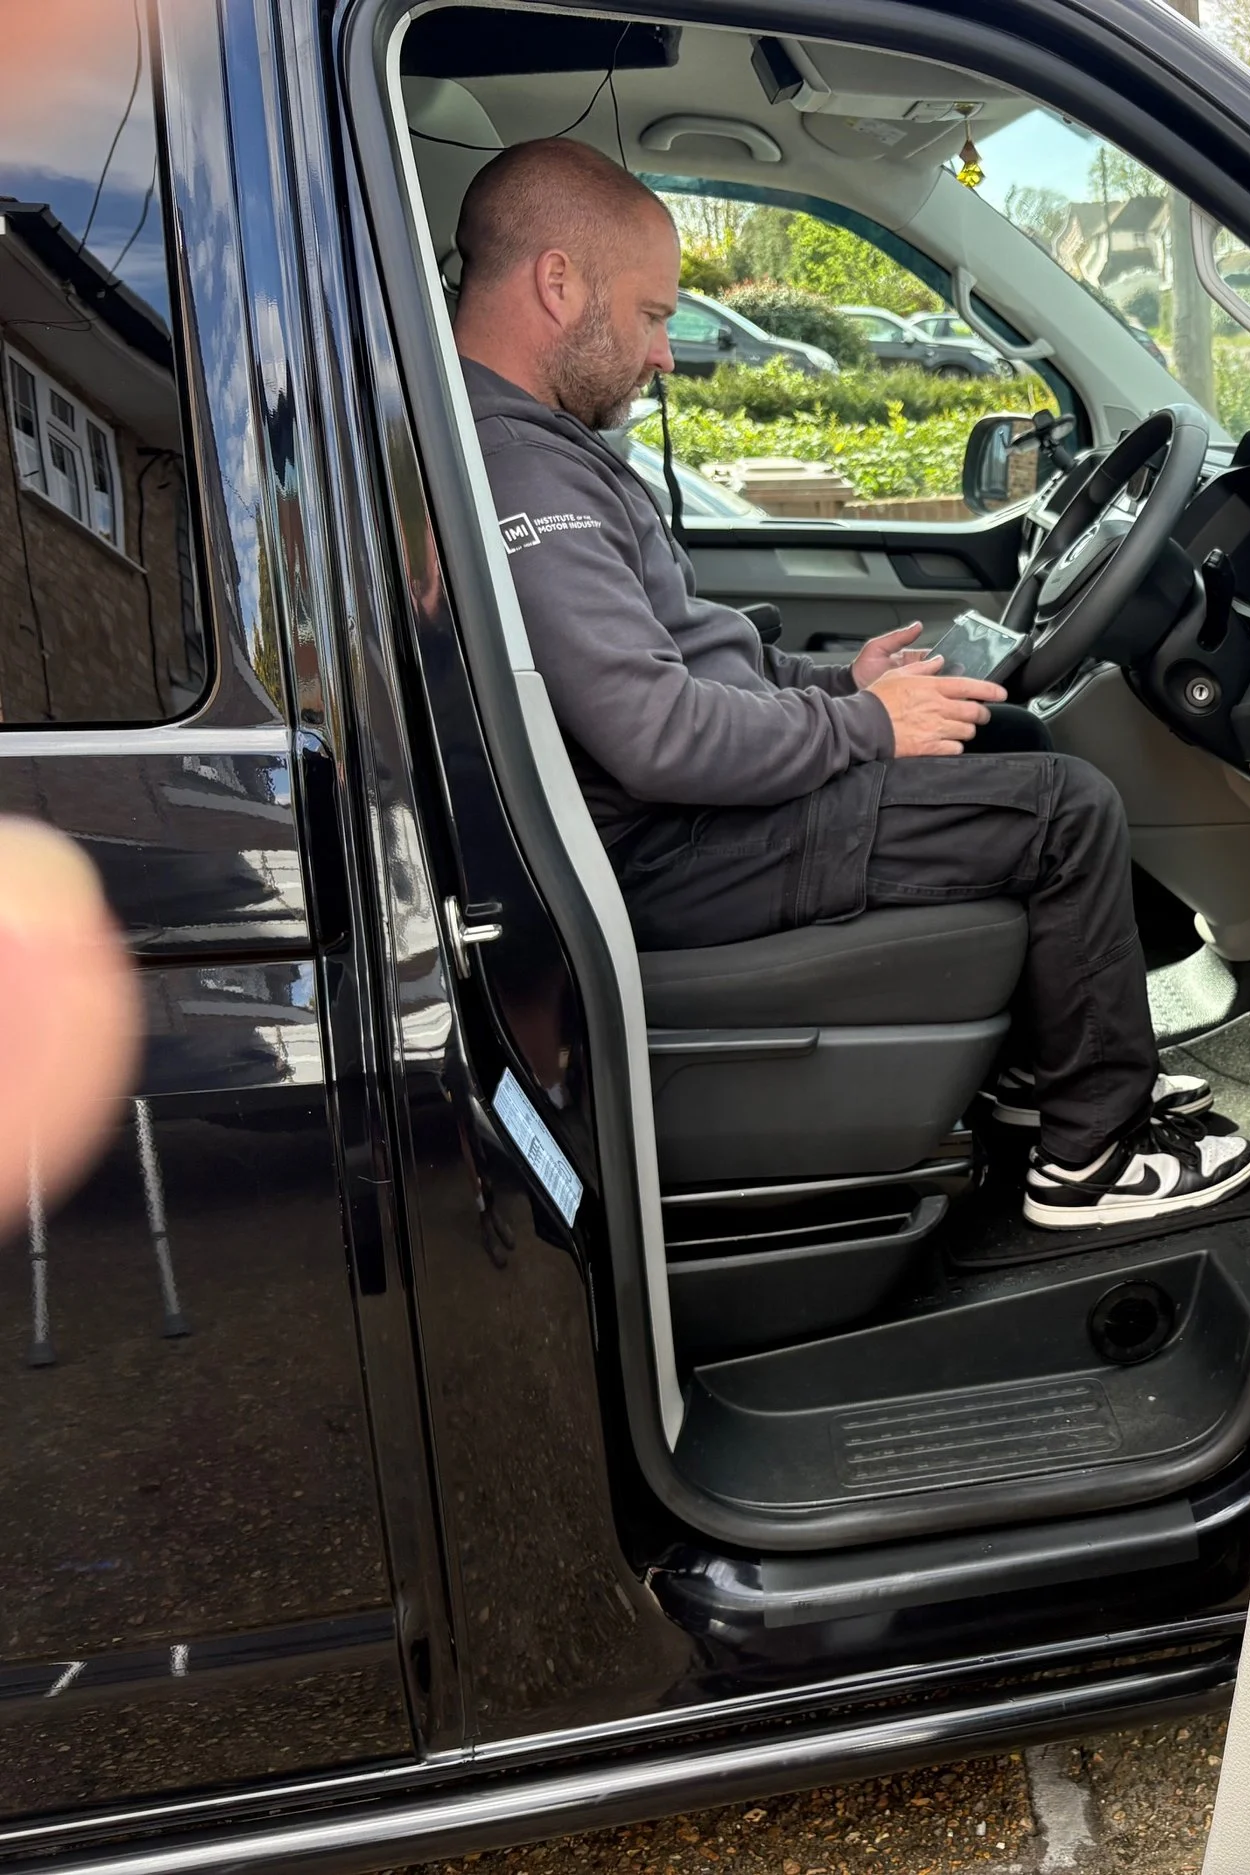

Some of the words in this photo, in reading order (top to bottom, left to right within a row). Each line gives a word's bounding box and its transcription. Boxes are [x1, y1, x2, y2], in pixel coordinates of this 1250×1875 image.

[533, 514, 576, 526] INSTITUTE
[537, 522, 569, 534] MOTOR
[568, 520, 602, 529] INDUSTRY
[504, 523, 529, 542] IMI
